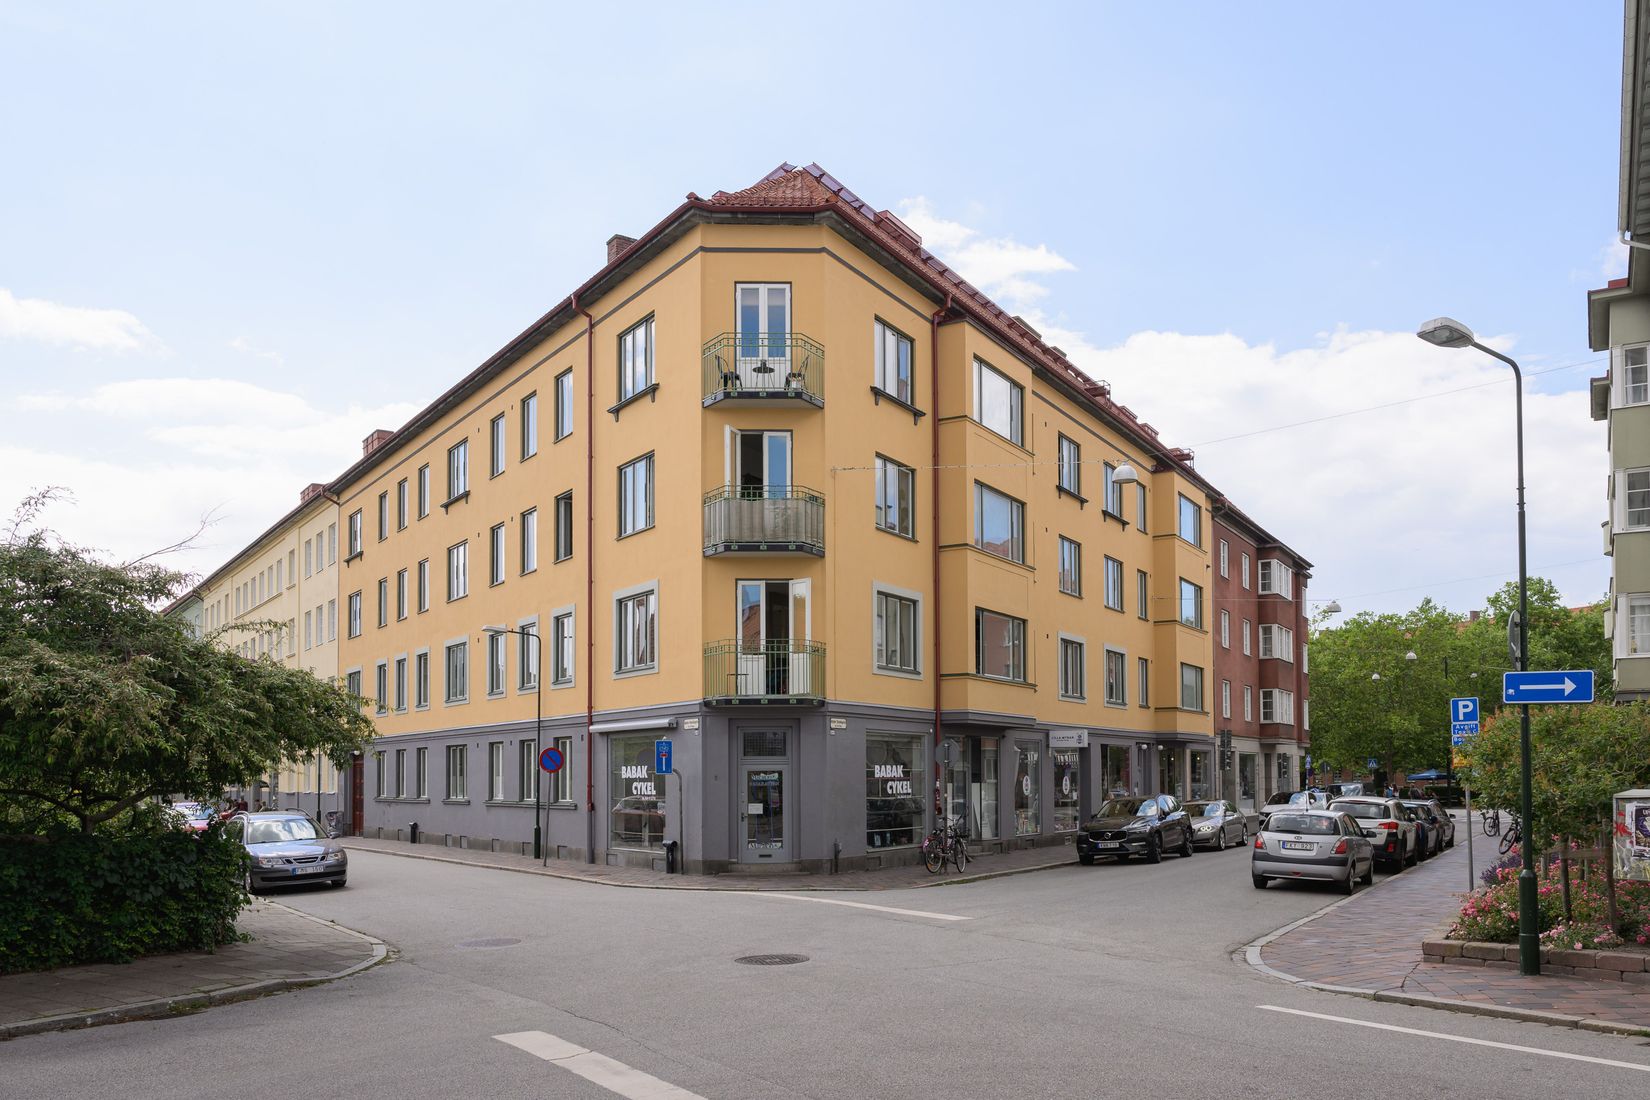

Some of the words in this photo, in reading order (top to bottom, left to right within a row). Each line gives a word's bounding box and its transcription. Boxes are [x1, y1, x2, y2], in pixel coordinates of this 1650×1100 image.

[1458, 700, 1474, 721] P
[621, 765, 648, 778] BABAK
[874, 765, 904, 778] BABAK
[632, 782, 656, 795] CYKEL
[887, 781, 912, 794] CYKEL
